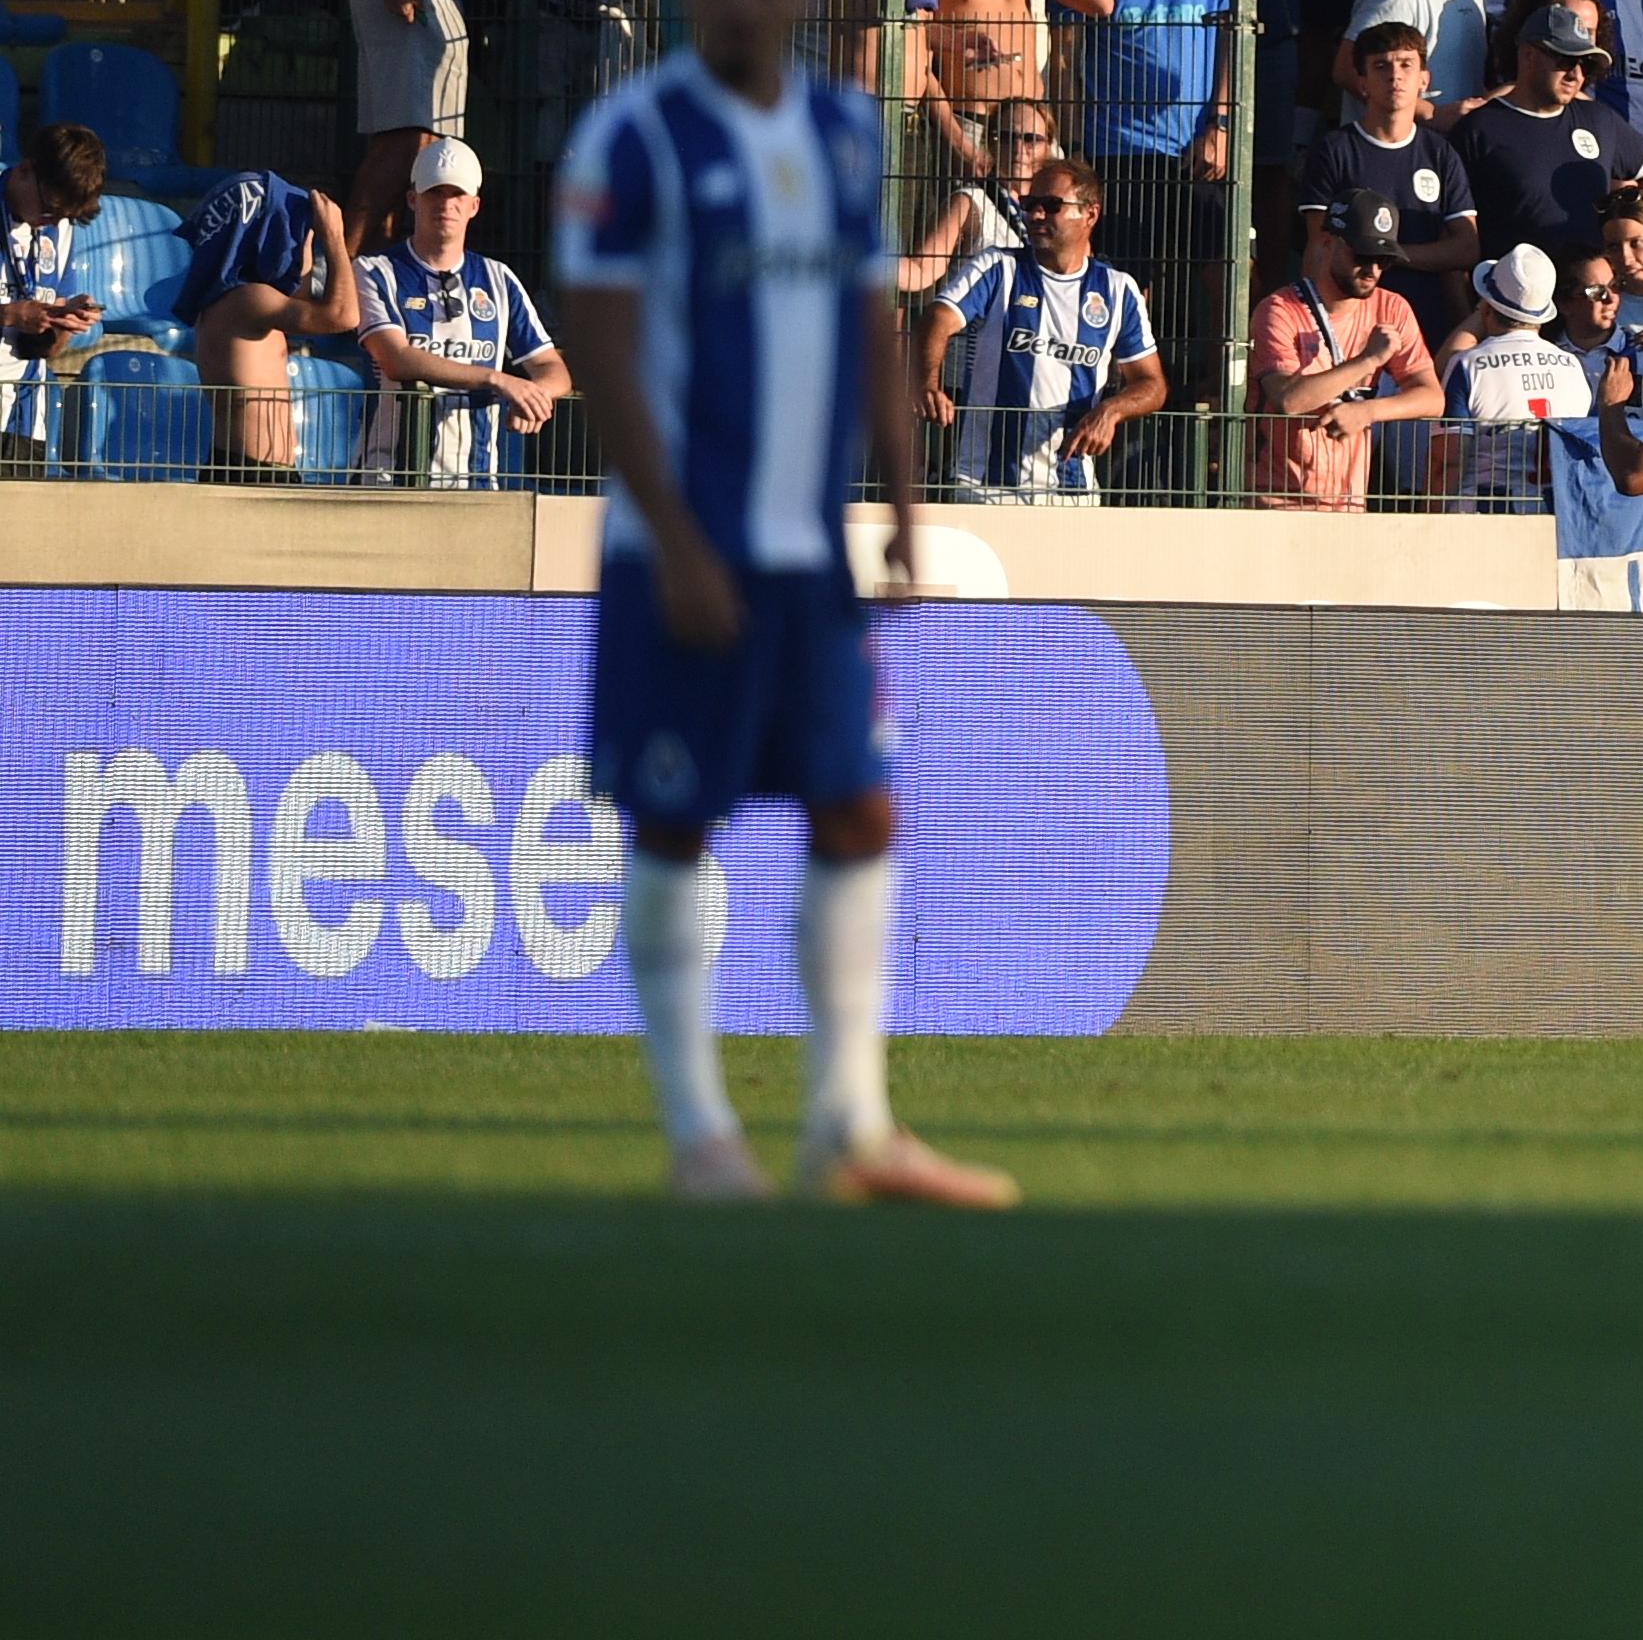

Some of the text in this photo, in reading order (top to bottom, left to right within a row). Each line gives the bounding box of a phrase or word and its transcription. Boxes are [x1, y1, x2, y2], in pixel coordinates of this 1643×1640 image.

[407, 334, 496, 361] Betano
[1008, 328, 1102, 365] Betano
[1476, 351, 1576, 370] SUPER BOCK
[1522, 372, 1555, 392] BIVÓ
[60, 748, 728, 980] mese
